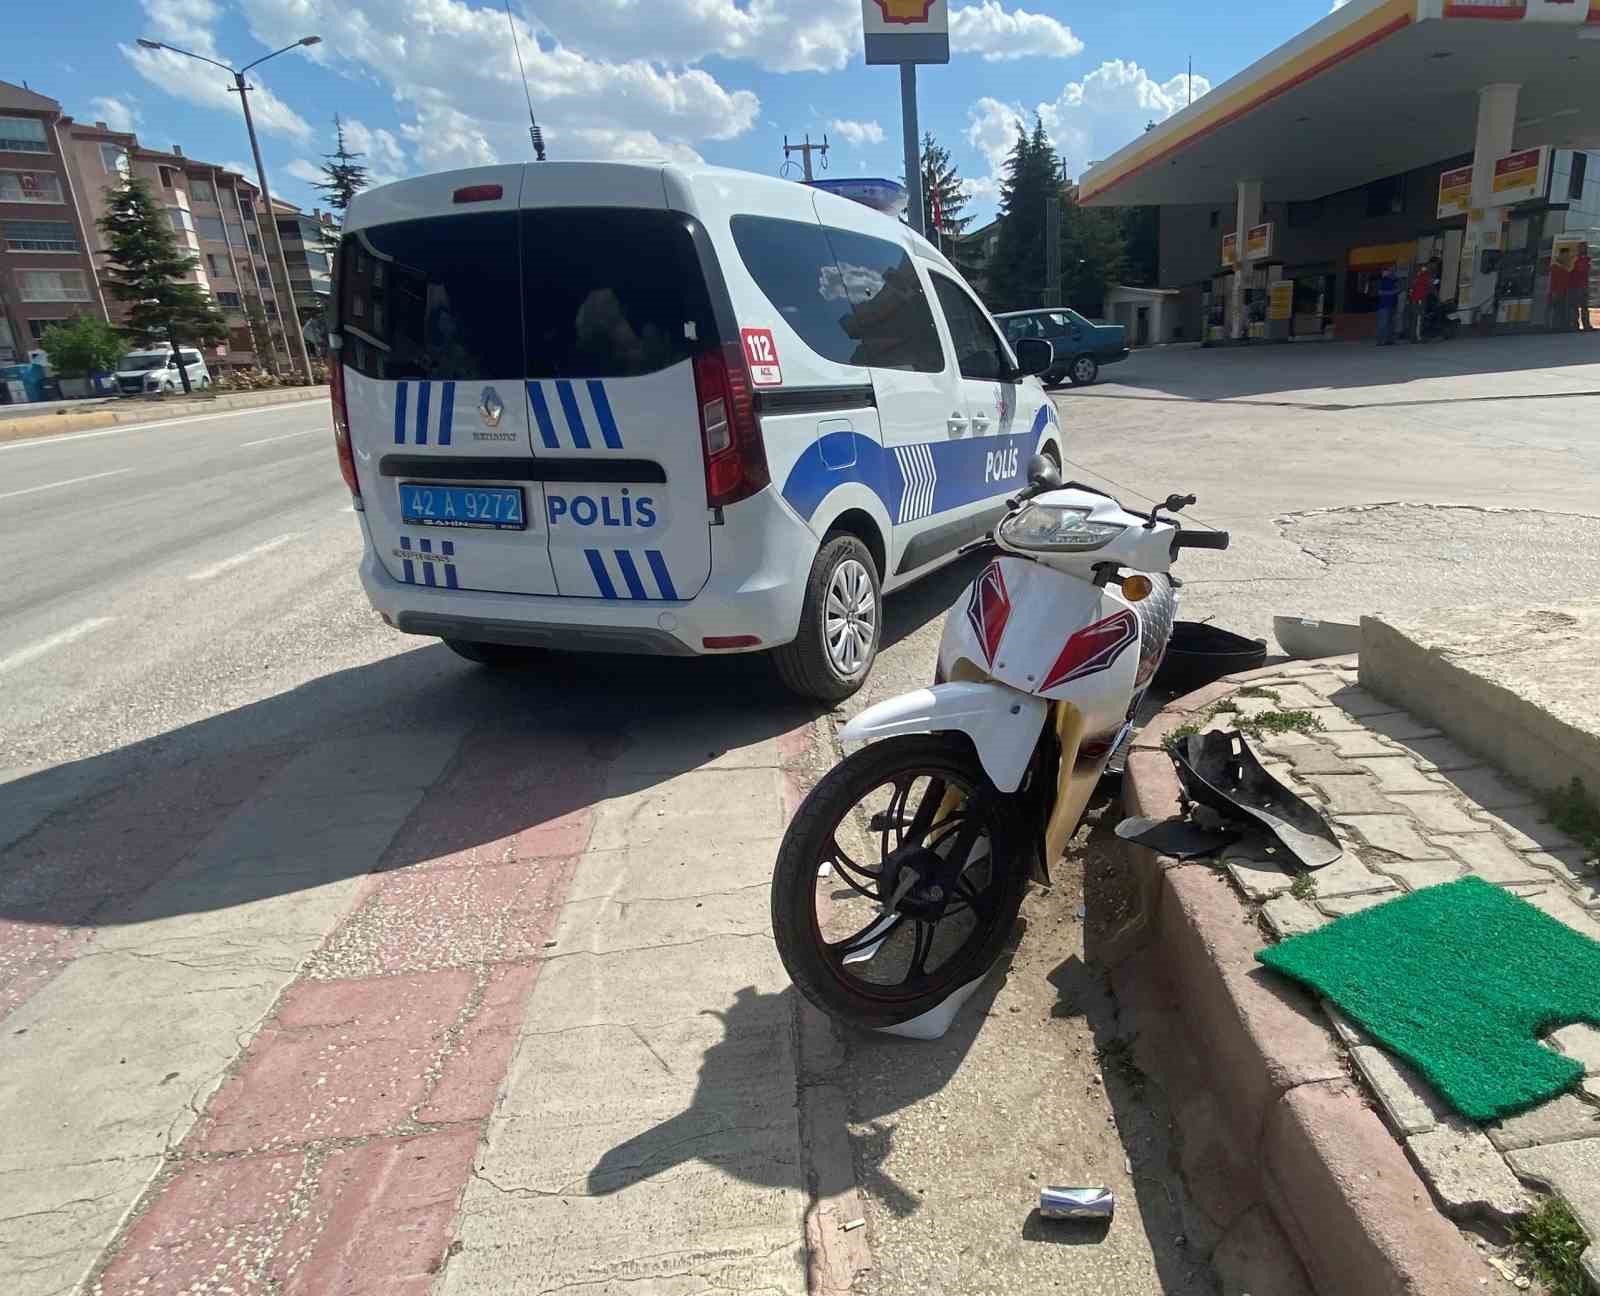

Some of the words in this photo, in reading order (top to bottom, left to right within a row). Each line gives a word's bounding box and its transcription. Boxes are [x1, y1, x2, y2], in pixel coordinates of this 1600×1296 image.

[747, 335, 774, 361] 112
[985, 439, 1018, 483] POLİS
[411, 490, 435, 516] 42
[445, 491, 456, 517] A
[464, 493, 519, 521] 9272
[547, 488, 656, 527] POLİS
